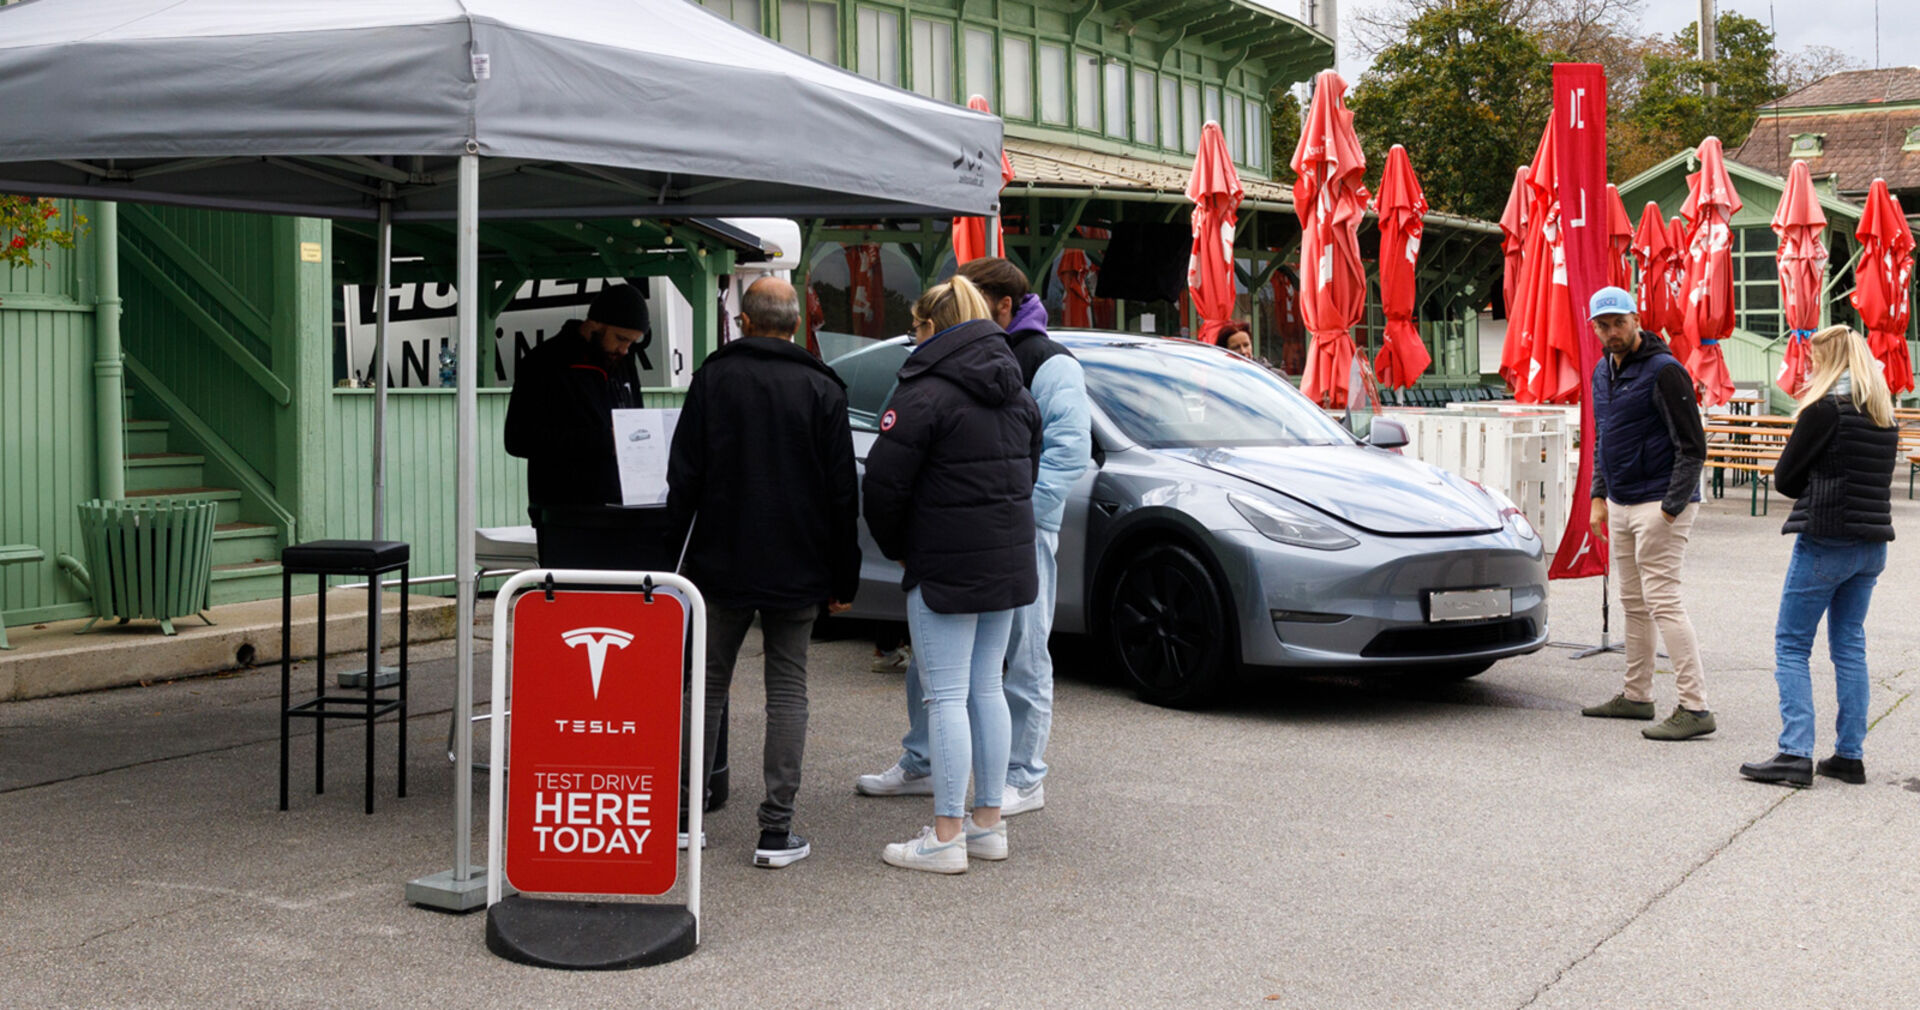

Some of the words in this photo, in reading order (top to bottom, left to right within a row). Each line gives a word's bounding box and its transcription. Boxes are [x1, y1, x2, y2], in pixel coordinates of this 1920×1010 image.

[555, 720, 635, 734] TESLA
[534, 772, 584, 790] TEST
[591, 774, 653, 791] DRIVE
[535, 792, 651, 826] HERE
[533, 827, 652, 854] TODAY
